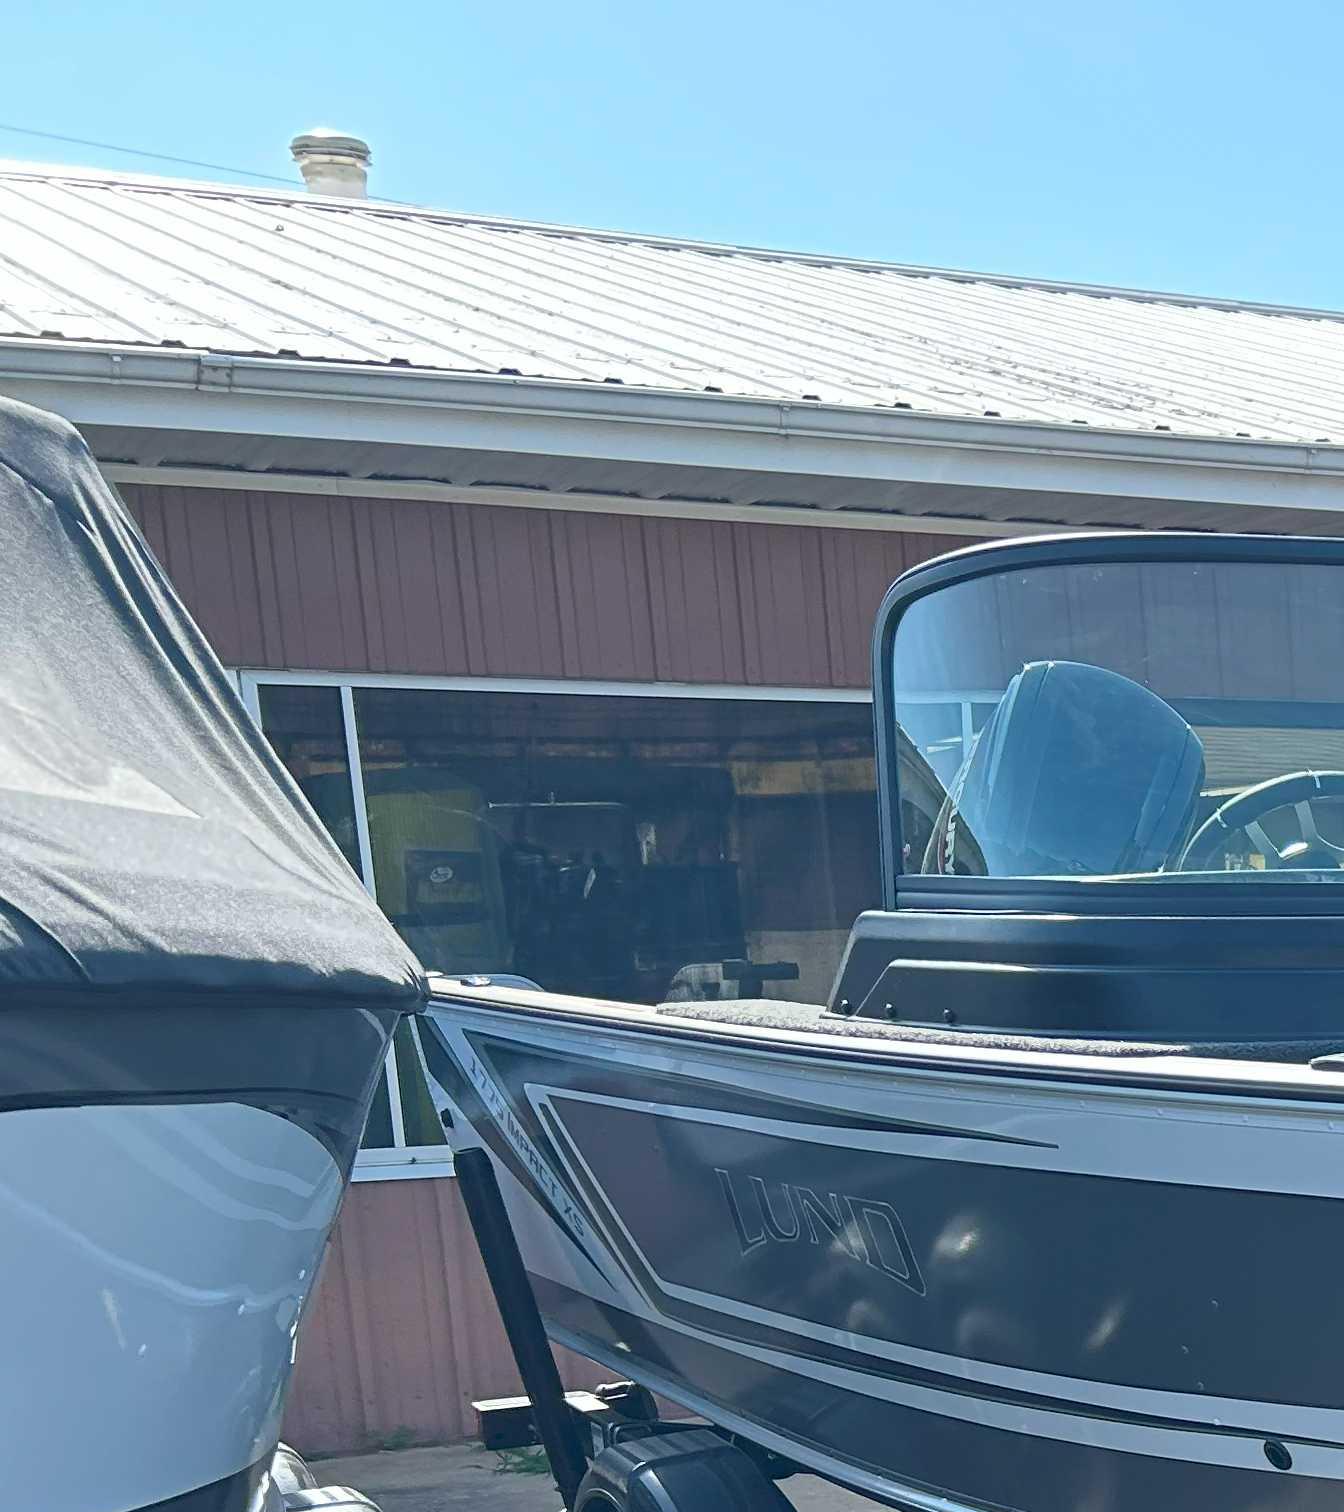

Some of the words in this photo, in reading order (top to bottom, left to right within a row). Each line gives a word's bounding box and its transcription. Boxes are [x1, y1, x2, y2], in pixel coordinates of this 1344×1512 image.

[470, 1056, 505, 1121] 1775
[507, 1111, 559, 1197] IMPACT
[563, 1204, 586, 1238] XS
[714, 1167, 927, 1297] LUND
